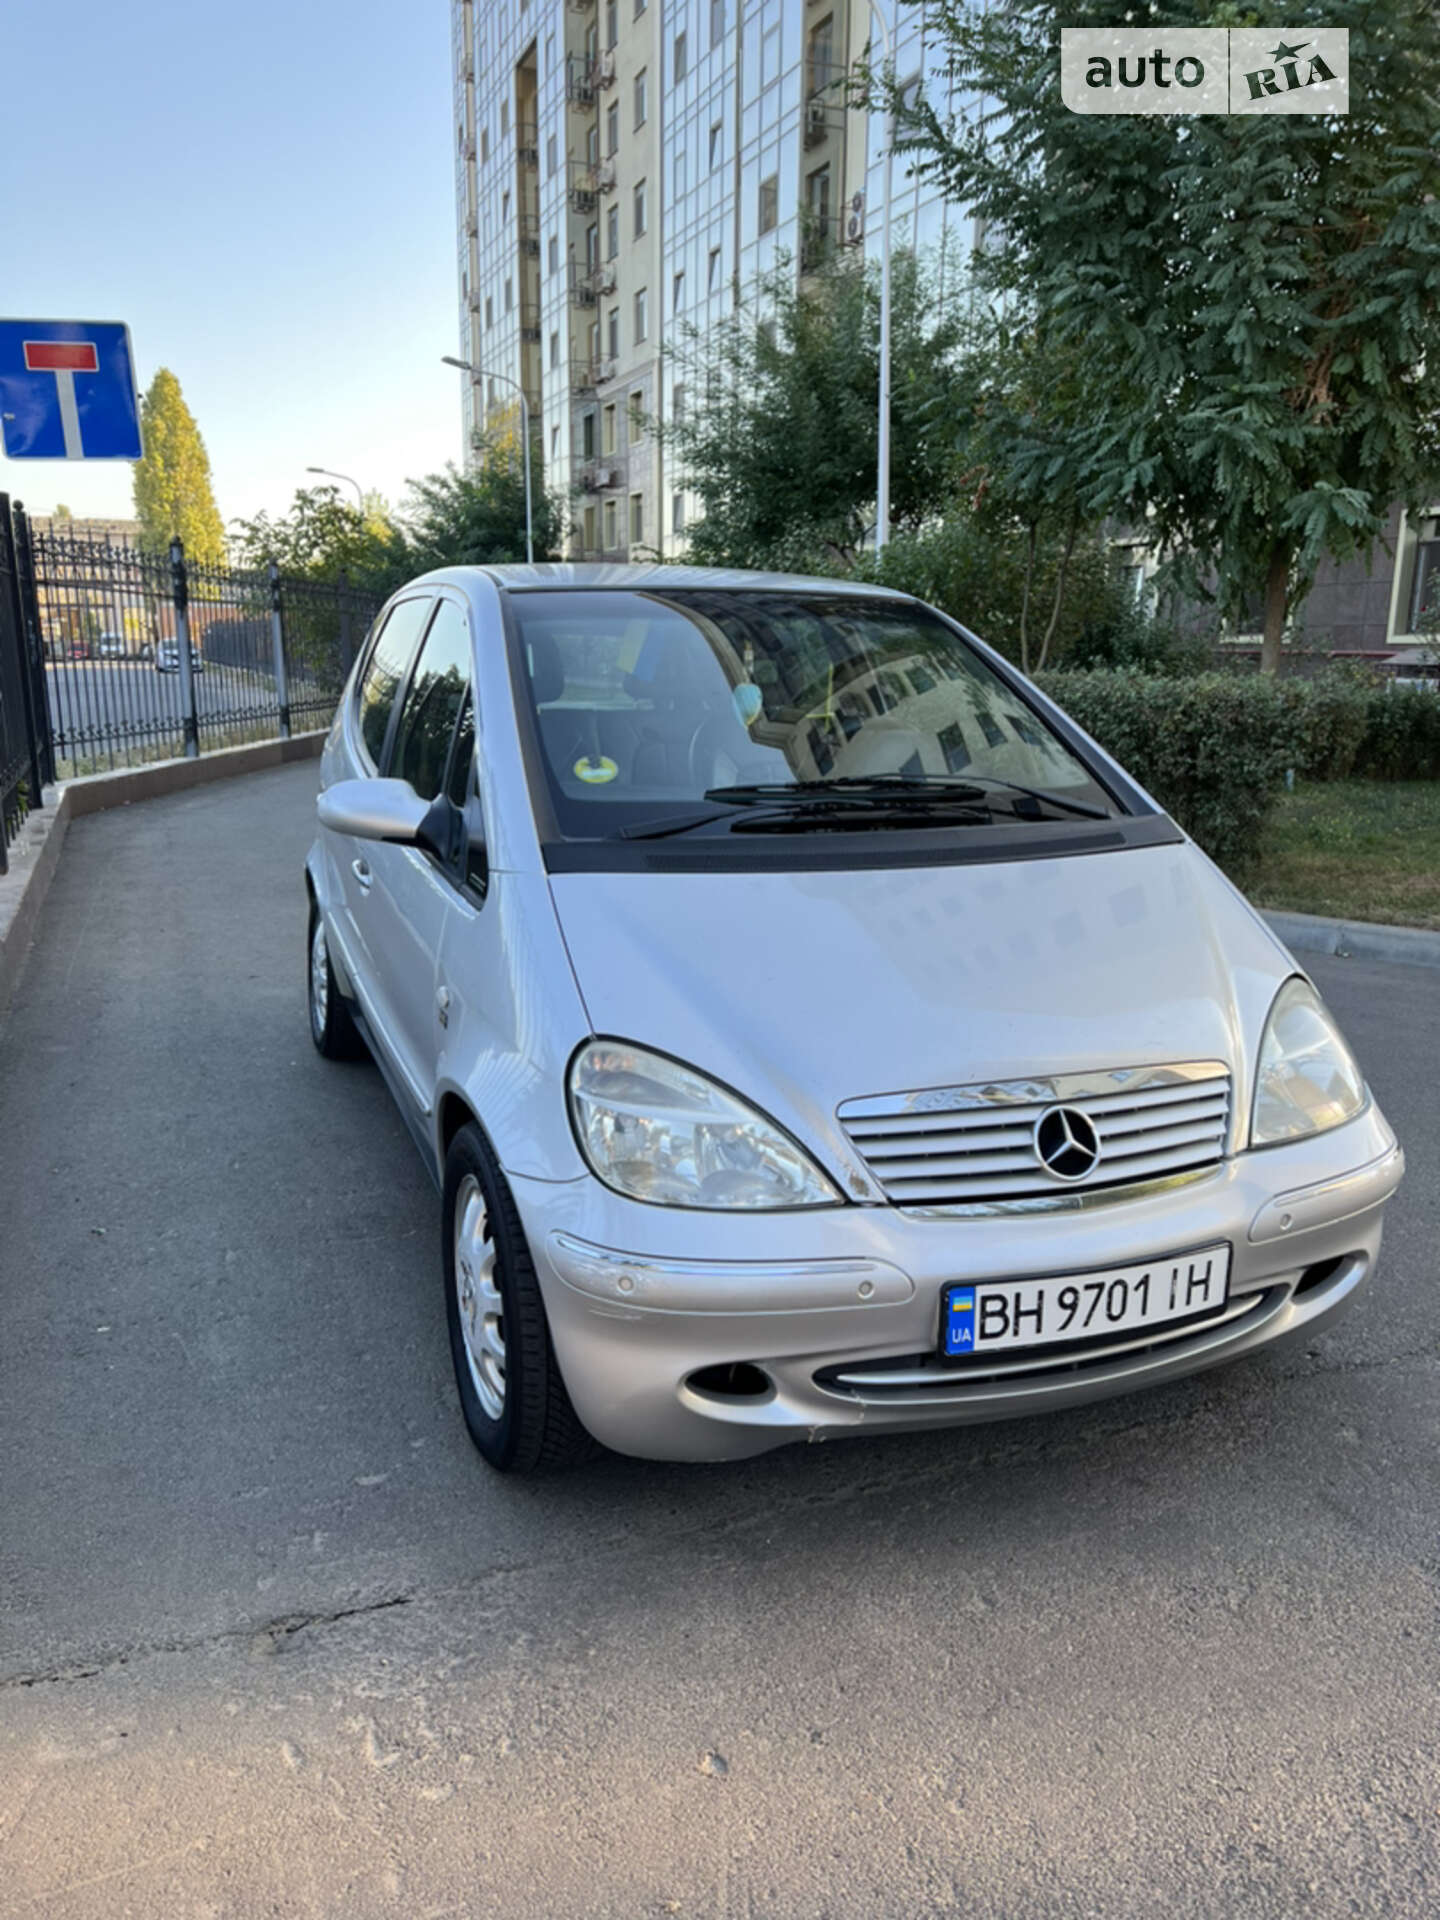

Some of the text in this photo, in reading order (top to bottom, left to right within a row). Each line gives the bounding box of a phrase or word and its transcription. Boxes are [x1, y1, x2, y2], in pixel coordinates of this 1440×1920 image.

[978, 1260, 1213, 1340] BH 9701 IH
[952, 1327, 972, 1344] UA
